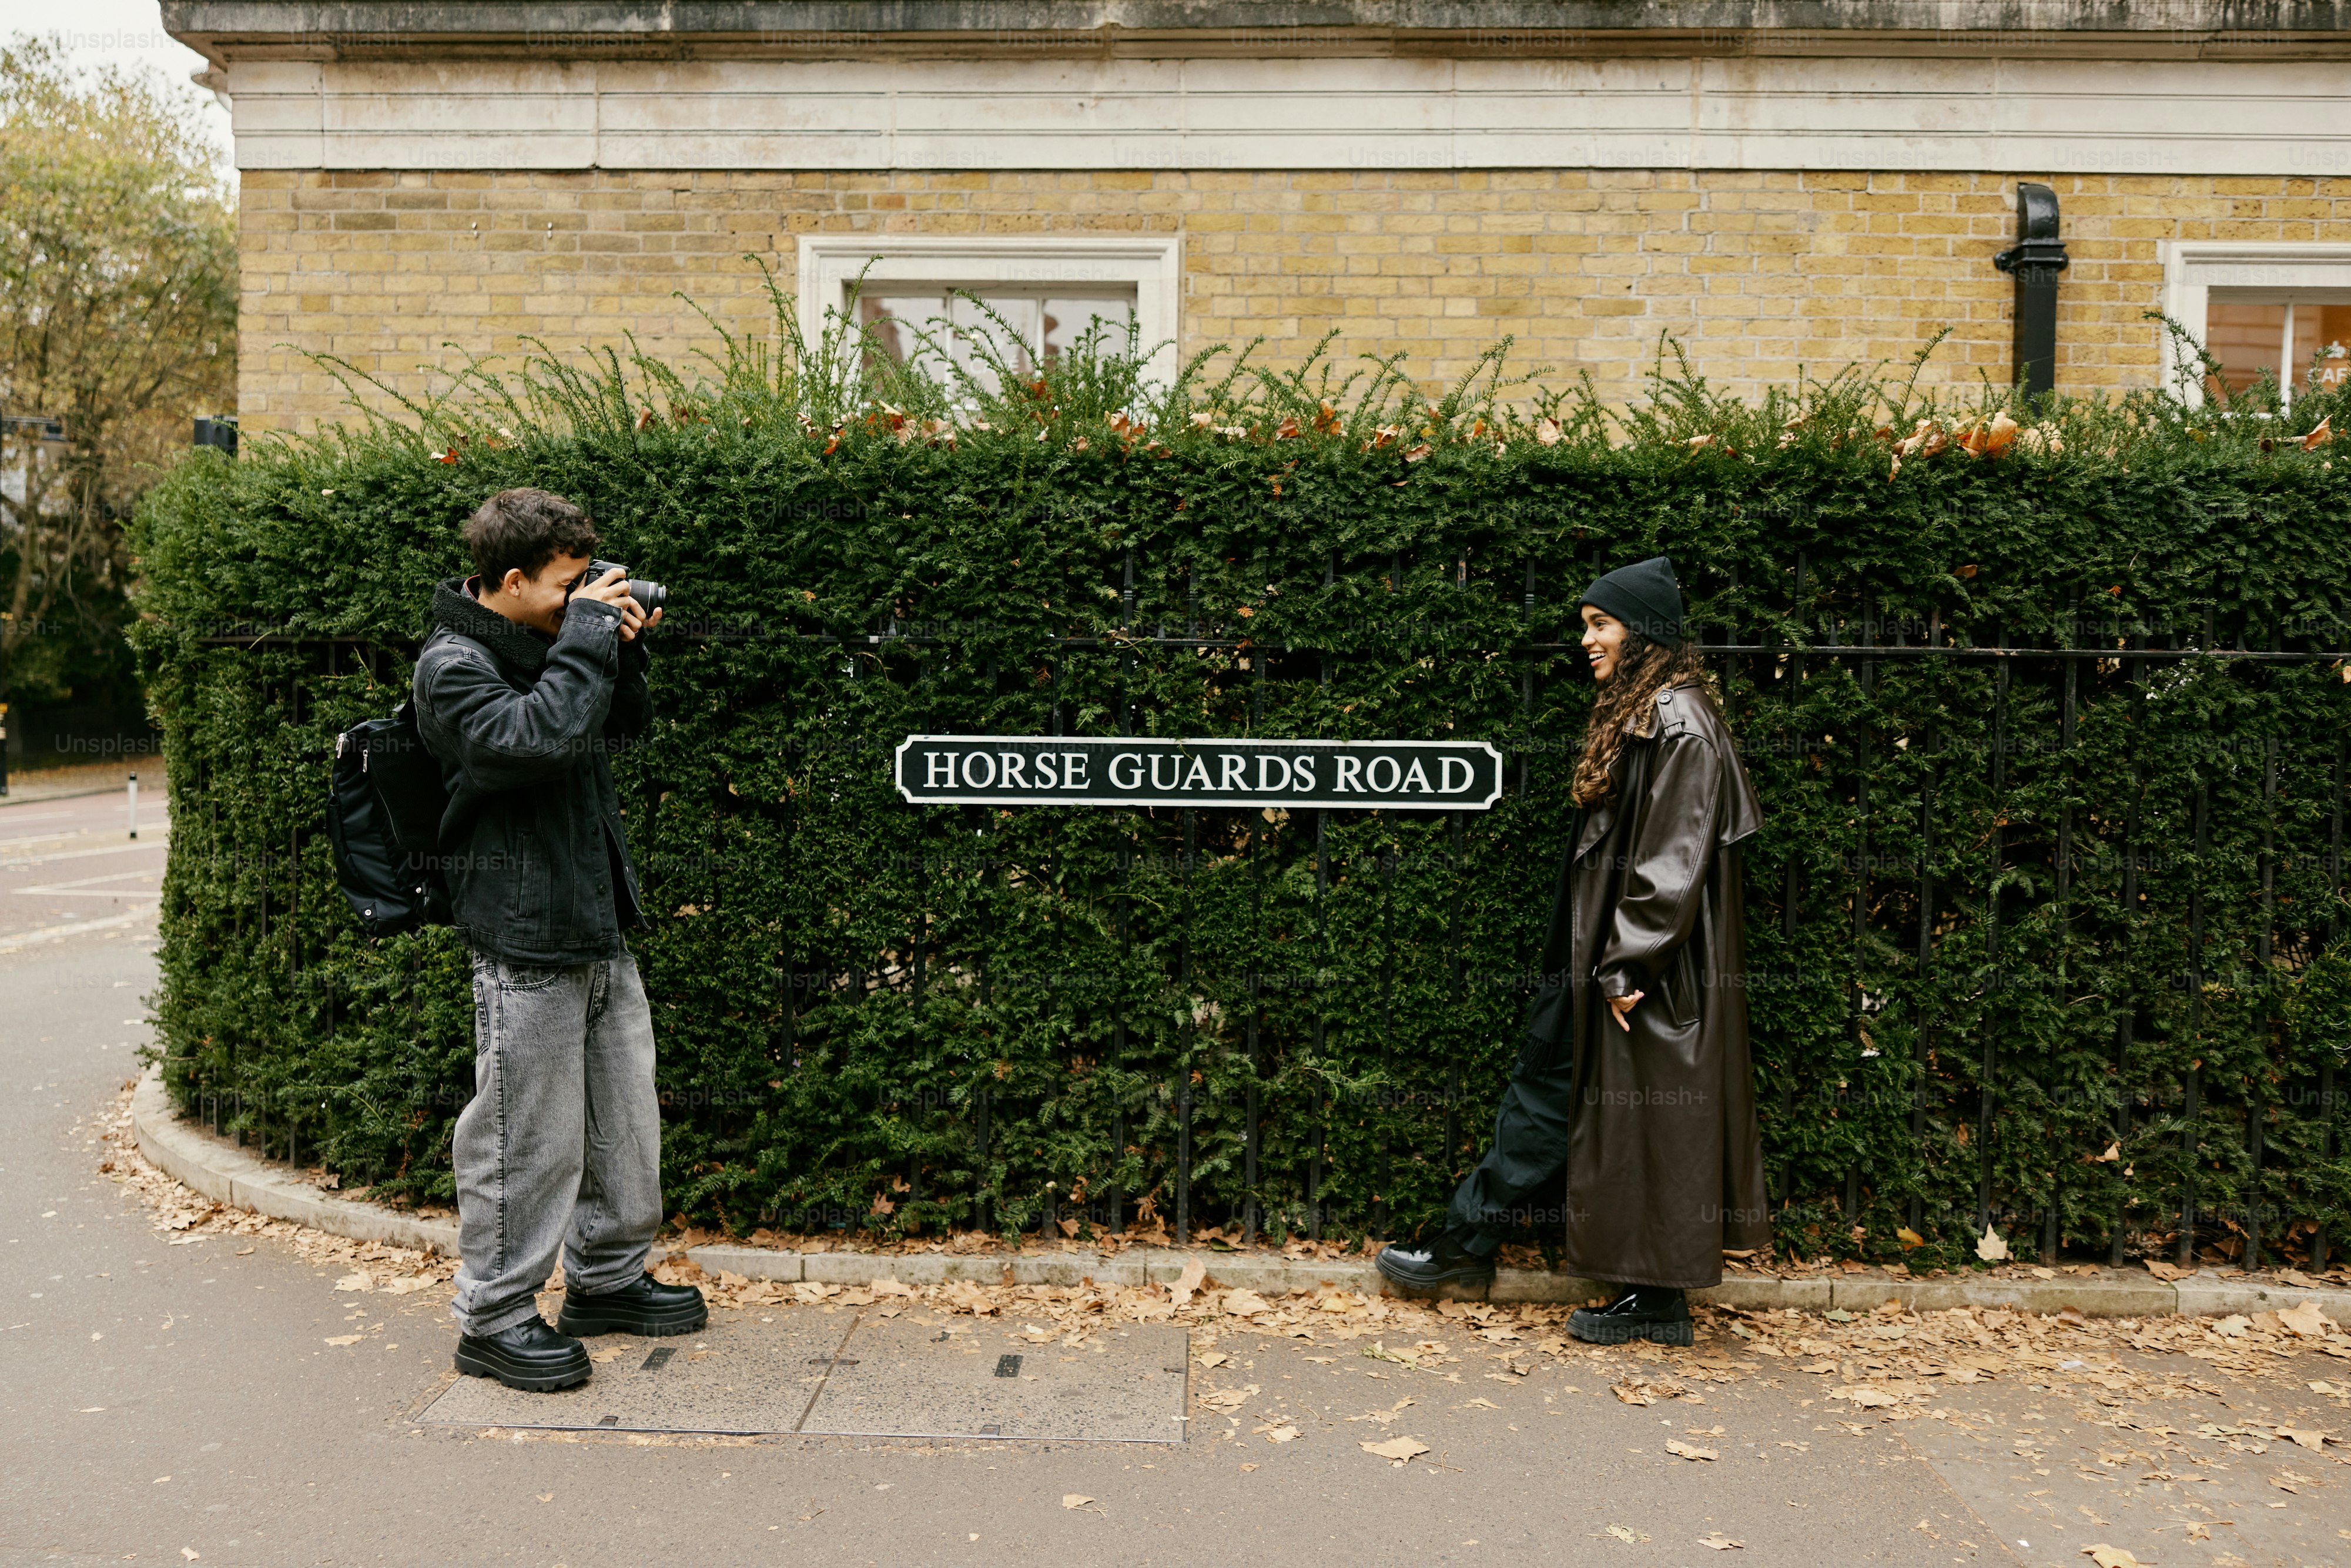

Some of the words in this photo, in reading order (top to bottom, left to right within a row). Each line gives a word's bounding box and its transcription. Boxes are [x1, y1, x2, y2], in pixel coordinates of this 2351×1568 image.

[2307, 367, 2351, 383] CAF
[923, 752, 1091, 789] HORSE
[1108, 753, 1316, 792] GUARDS
[1332, 756, 1475, 793] ROAD
